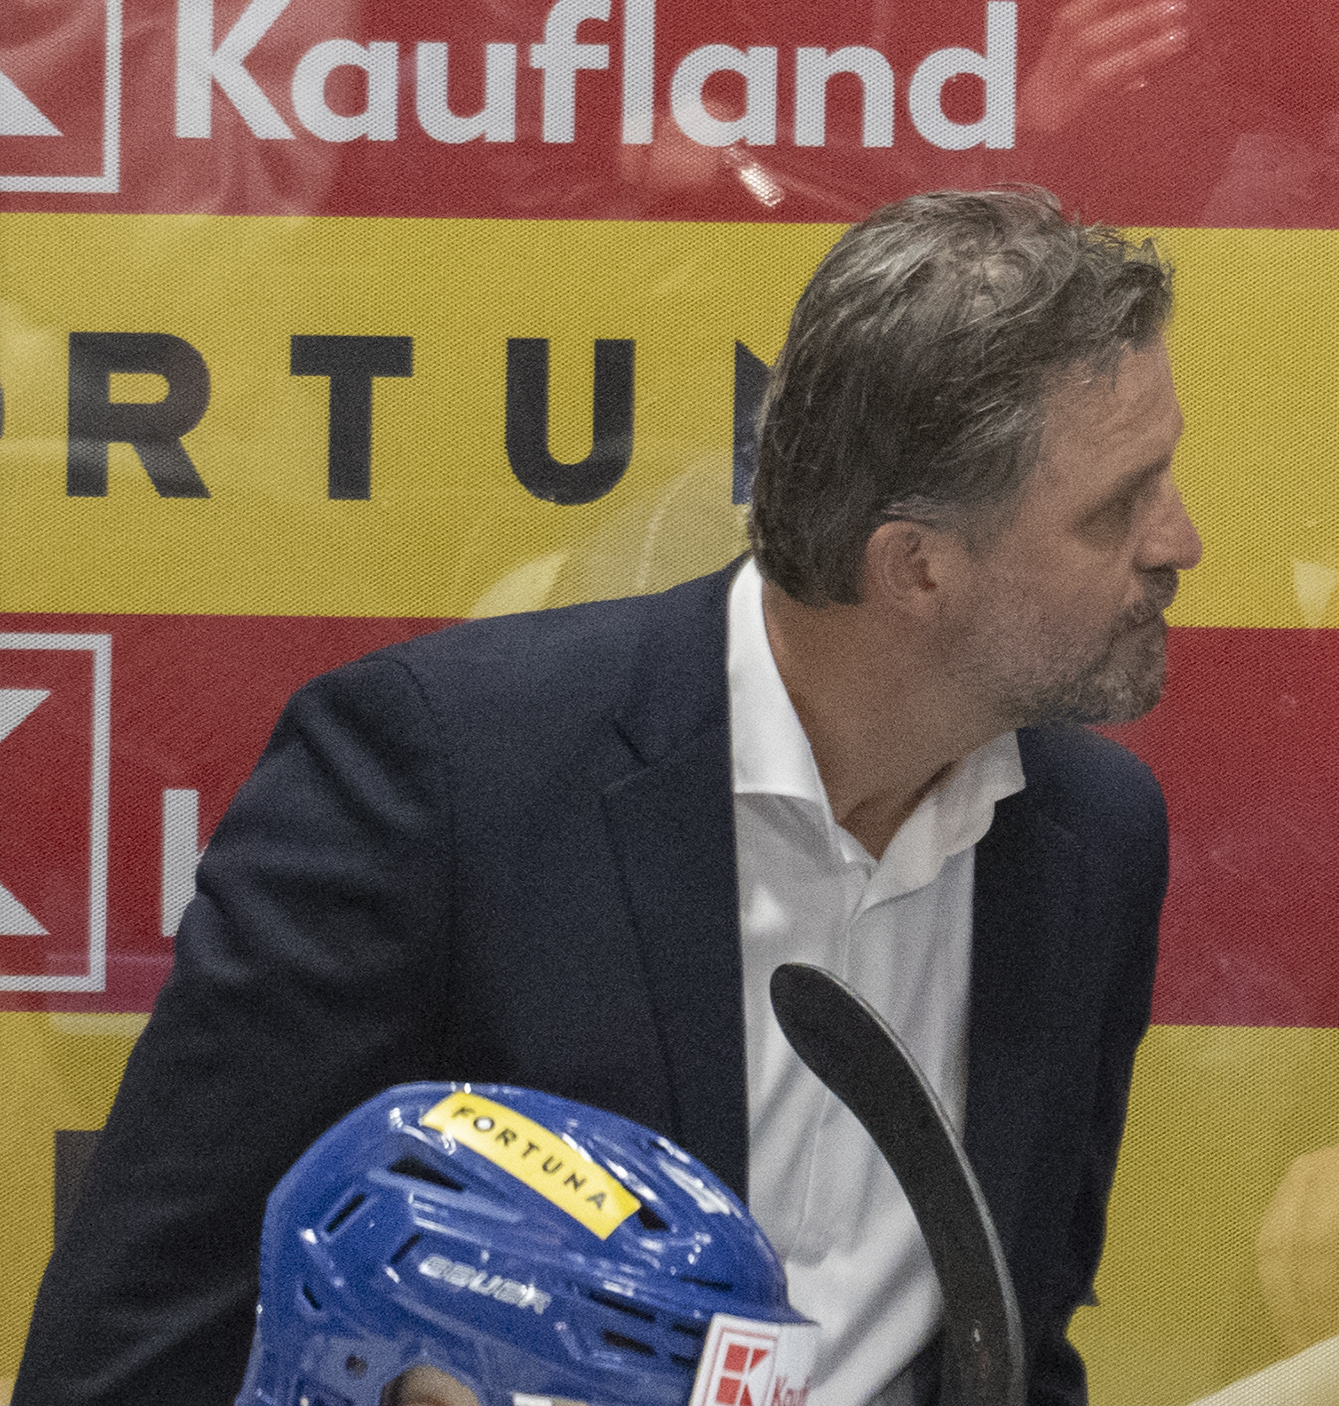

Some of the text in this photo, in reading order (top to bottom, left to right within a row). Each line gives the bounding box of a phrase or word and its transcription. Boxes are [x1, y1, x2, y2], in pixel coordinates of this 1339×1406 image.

[174, 0, 1018, 149] Kaufland
[0, 332, 778, 505] RTU
[451, 1106, 607, 1211] FORTUNA
